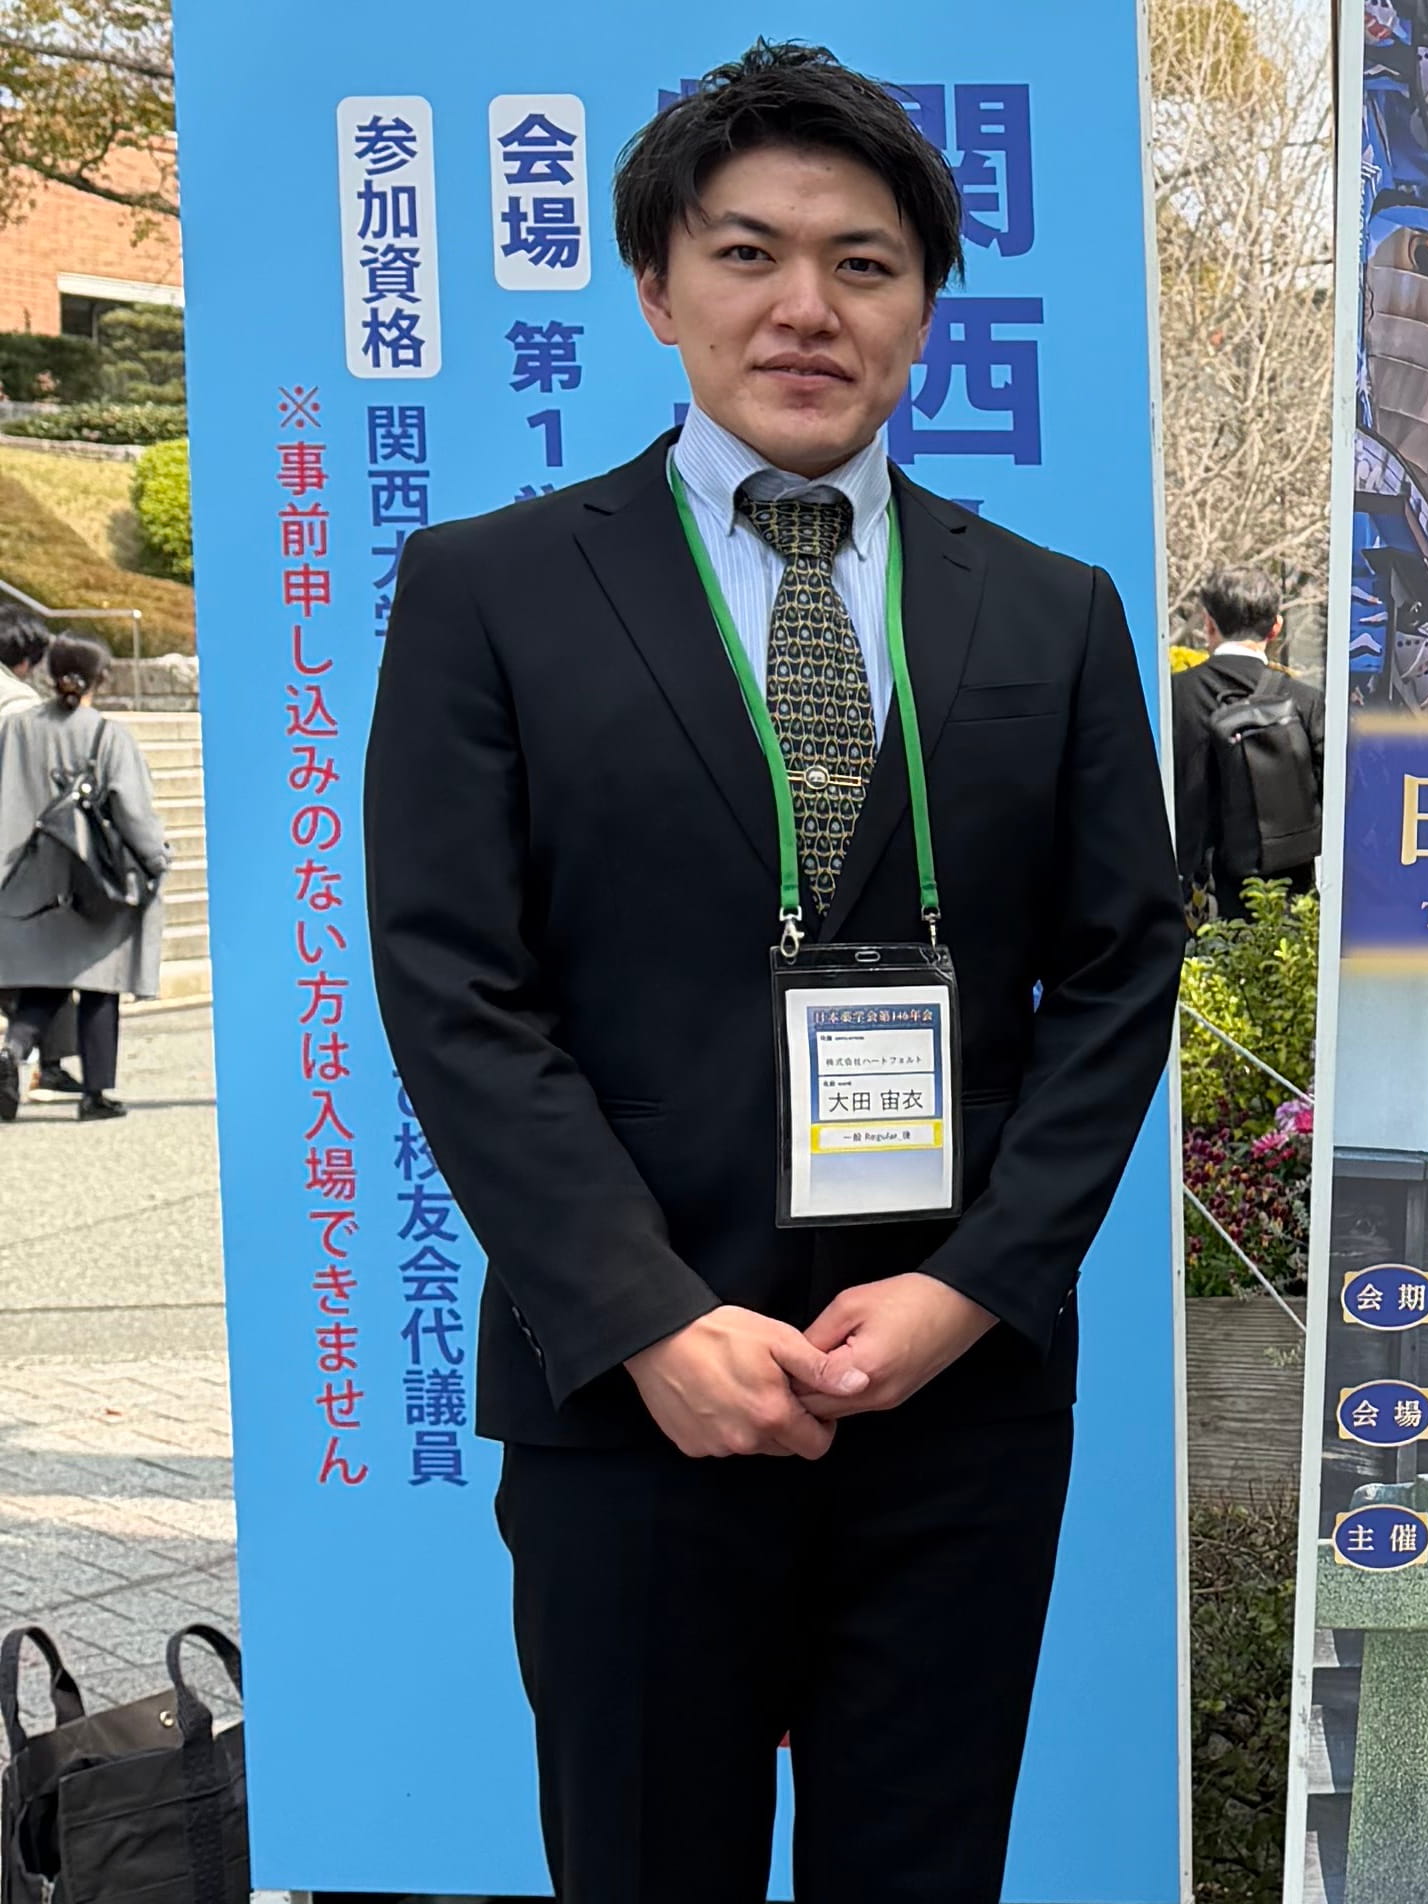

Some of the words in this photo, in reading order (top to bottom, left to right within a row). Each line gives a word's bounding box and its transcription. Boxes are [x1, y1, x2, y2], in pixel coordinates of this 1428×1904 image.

[497, 111, 583, 270] 会場
[353, 114, 426, 370] 参加資格
[504, 321, 586, 500] 第1
[276, 385, 369, 1486] ※事前申し込みのない方は入場できません
[828, 1091, 871, 1113] 大田
[1356, 1282, 1425, 1312] 会期
[1351, 1399, 1423, 1428] 会場
[1347, 1523, 1418, 1552] 主催
